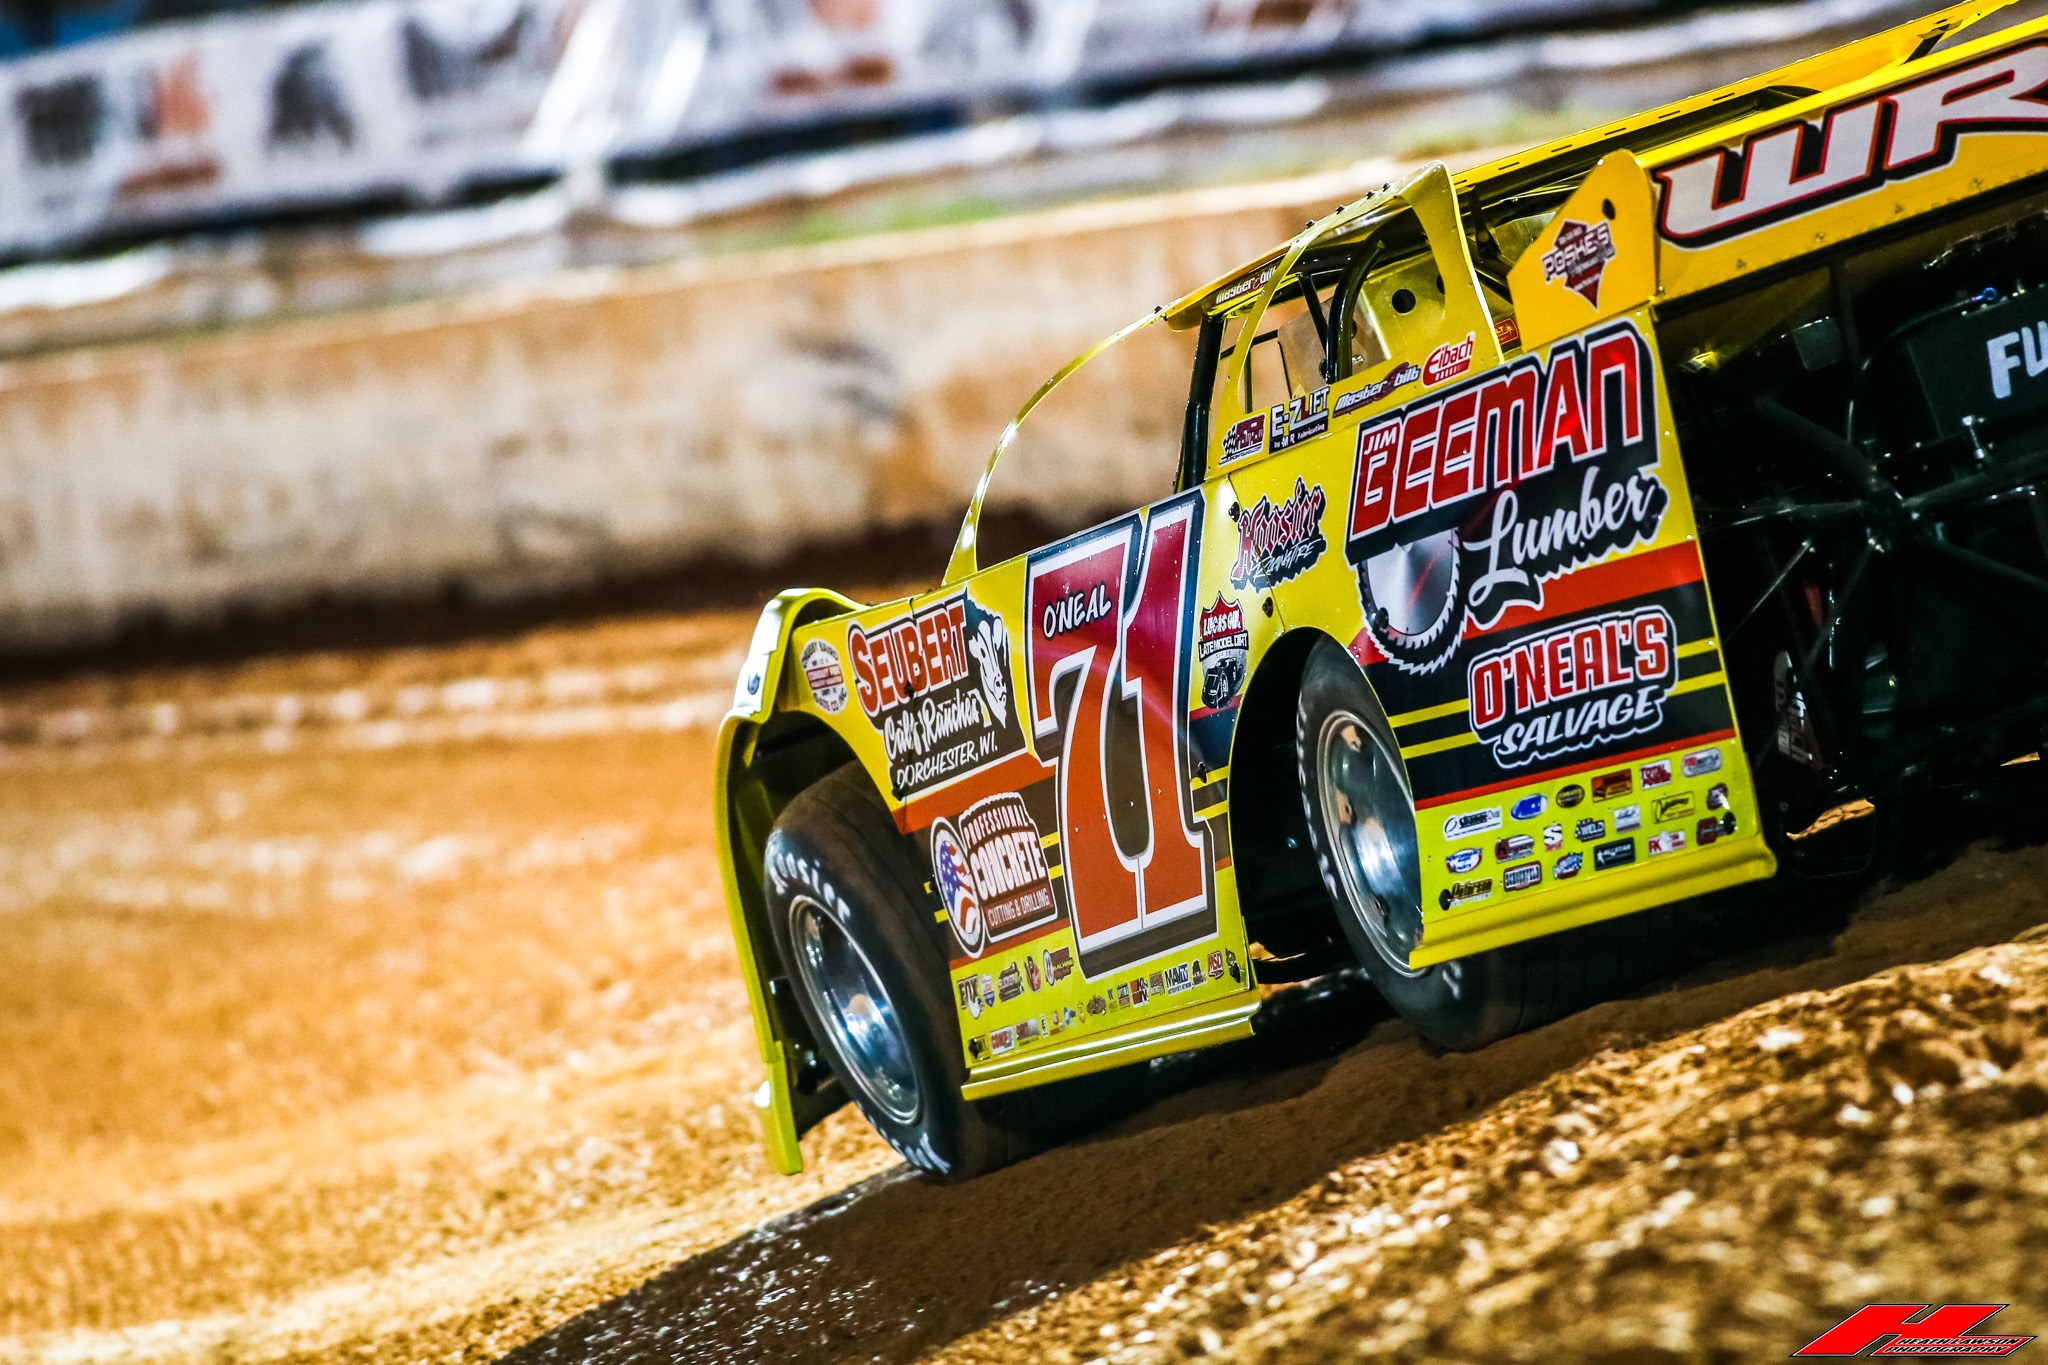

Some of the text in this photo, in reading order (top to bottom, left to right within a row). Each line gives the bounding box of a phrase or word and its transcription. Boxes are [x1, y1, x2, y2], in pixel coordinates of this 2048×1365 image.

[1422, 335, 1473, 385] Eibach
[1350, 331, 1643, 541] BEEMAN
[1363, 424, 1398, 455] JIM
[1463, 466, 1658, 606] Lumber
[1043, 584, 1112, 638] O'NEAL
[1203, 613, 1228, 637] LUCAS
[850, 600, 968, 716] SEUBERT
[1472, 613, 1668, 730] O'NEAL'S
[1029, 500, 1209, 955] 71
[1498, 685, 1660, 754] SALVAGE
[897, 730, 998, 789] DORCHESTER, WI.
[963, 804, 1029, 850] PROFESSIONAL
[970, 830, 1047, 901] CONCRETE
[987, 901, 1012, 926] CUTTING
[1020, 889, 1050, 916] DRILLING
